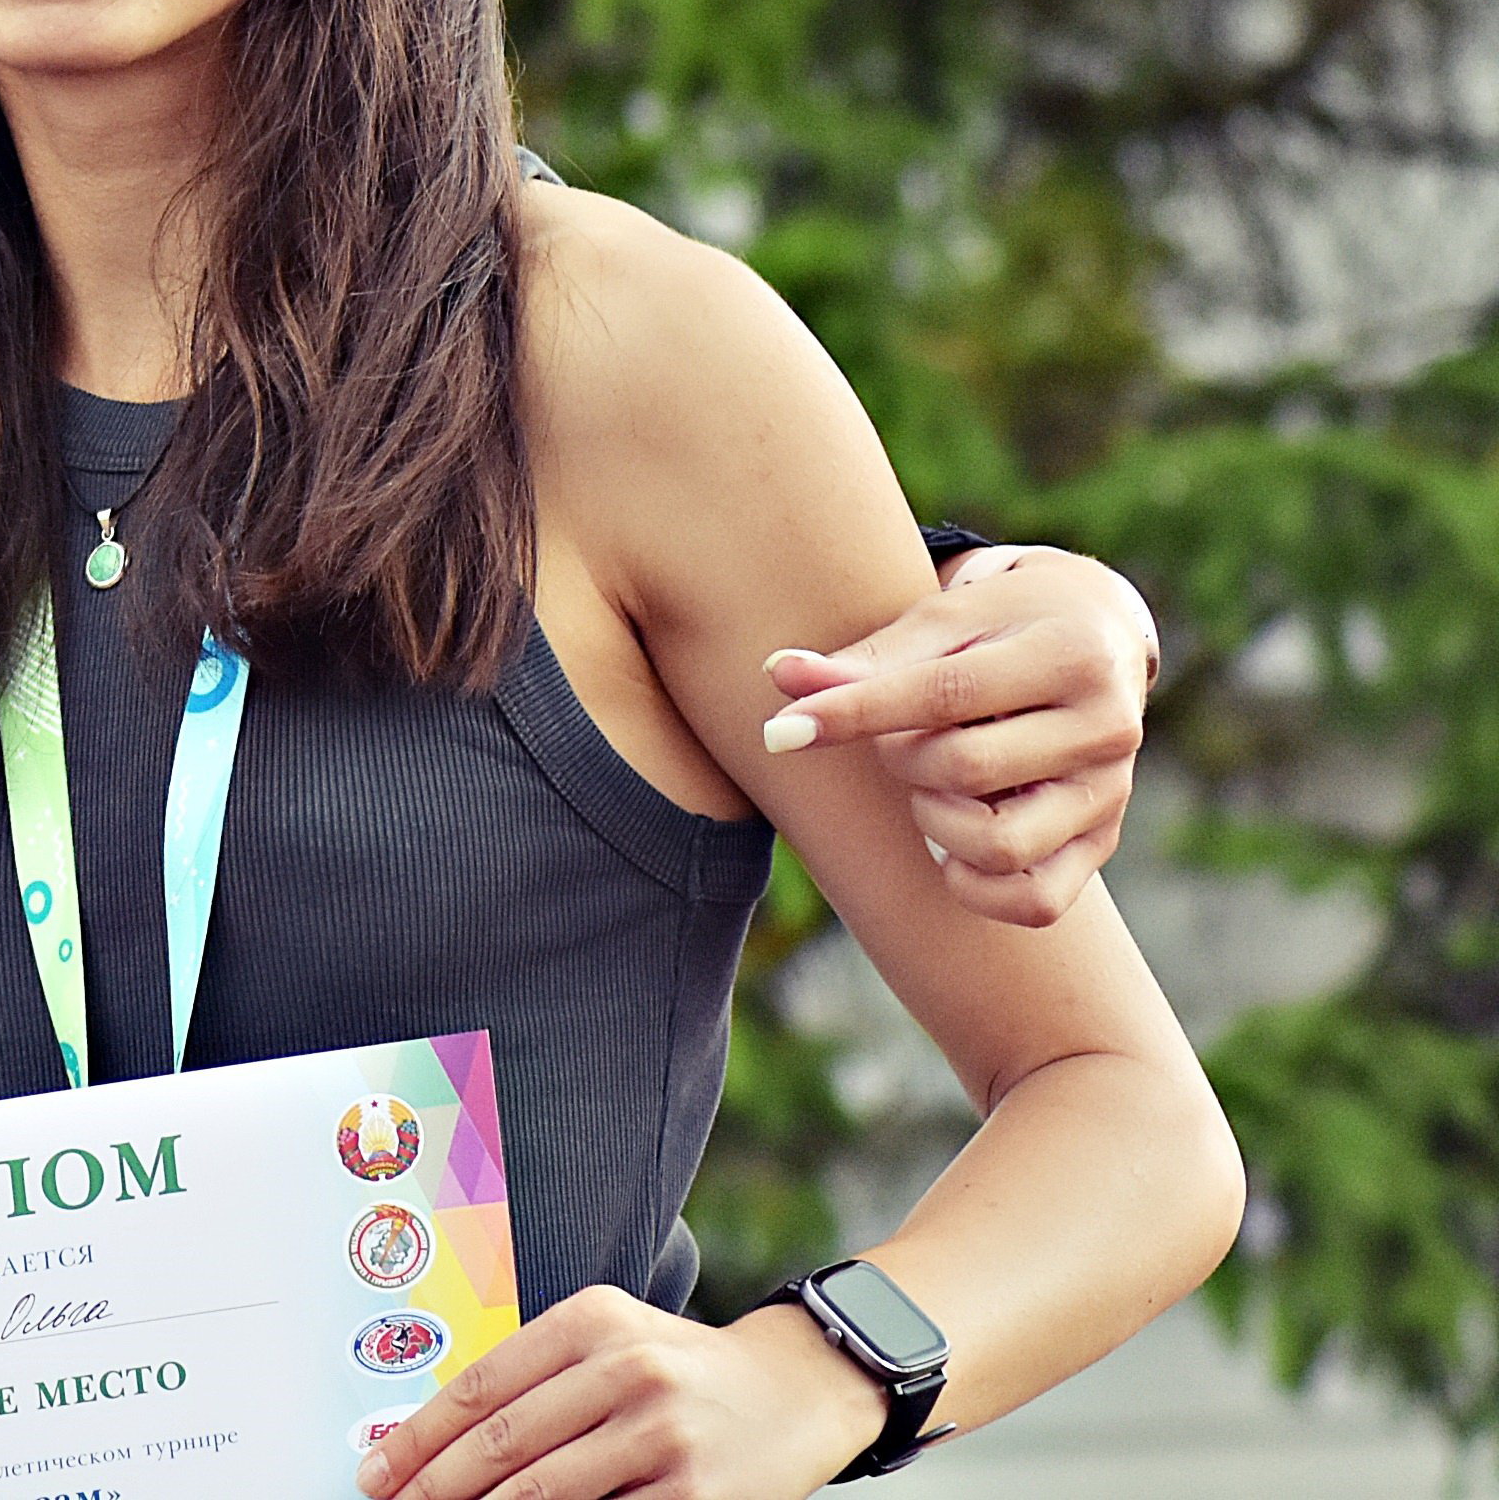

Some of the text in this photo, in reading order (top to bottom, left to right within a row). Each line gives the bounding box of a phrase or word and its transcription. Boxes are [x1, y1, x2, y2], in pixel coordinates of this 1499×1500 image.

[0, 1292, 114, 1341] Ольга
[35, 1361, 188, 1410] МЕСТО
[142, 1430, 239, 1461] турнире
